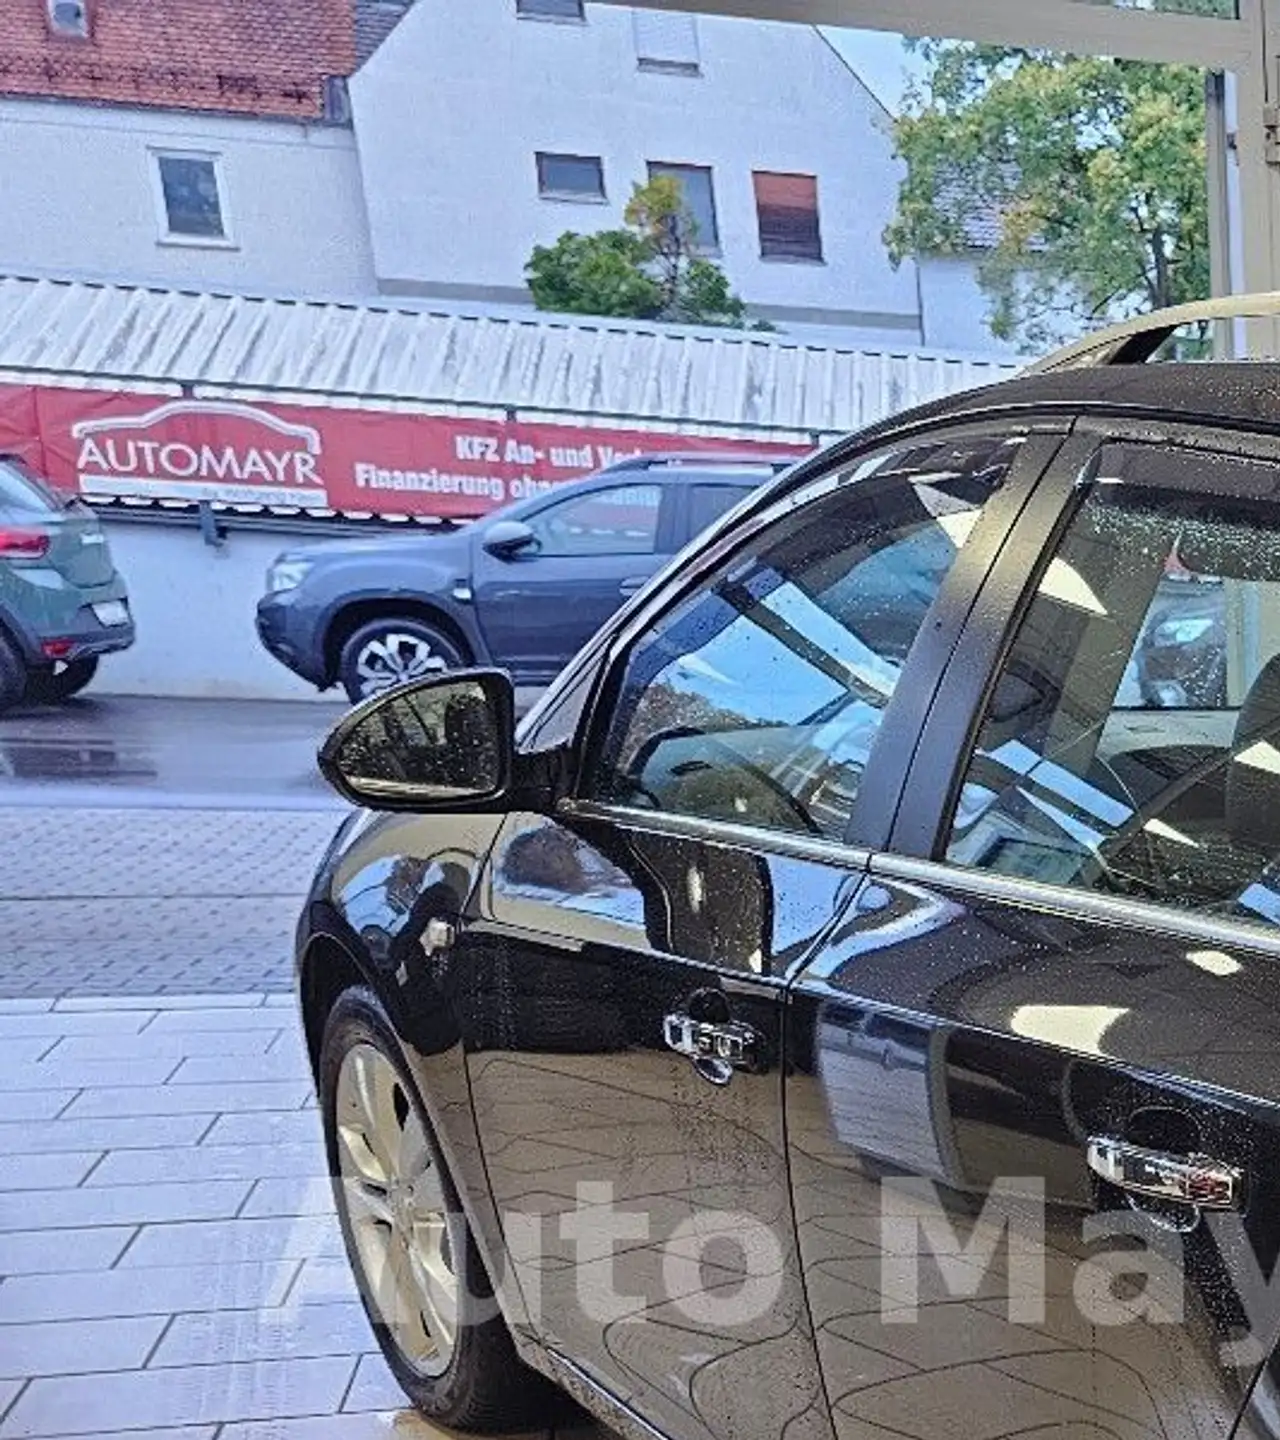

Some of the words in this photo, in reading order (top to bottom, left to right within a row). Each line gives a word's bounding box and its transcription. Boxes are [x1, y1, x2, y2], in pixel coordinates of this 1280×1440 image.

[77, 437, 325, 486] AUTOMAYR
[455, 436, 498, 462] KFZ
[551, 445, 593, 469] und
[354, 462, 505, 500] Finanzierung
